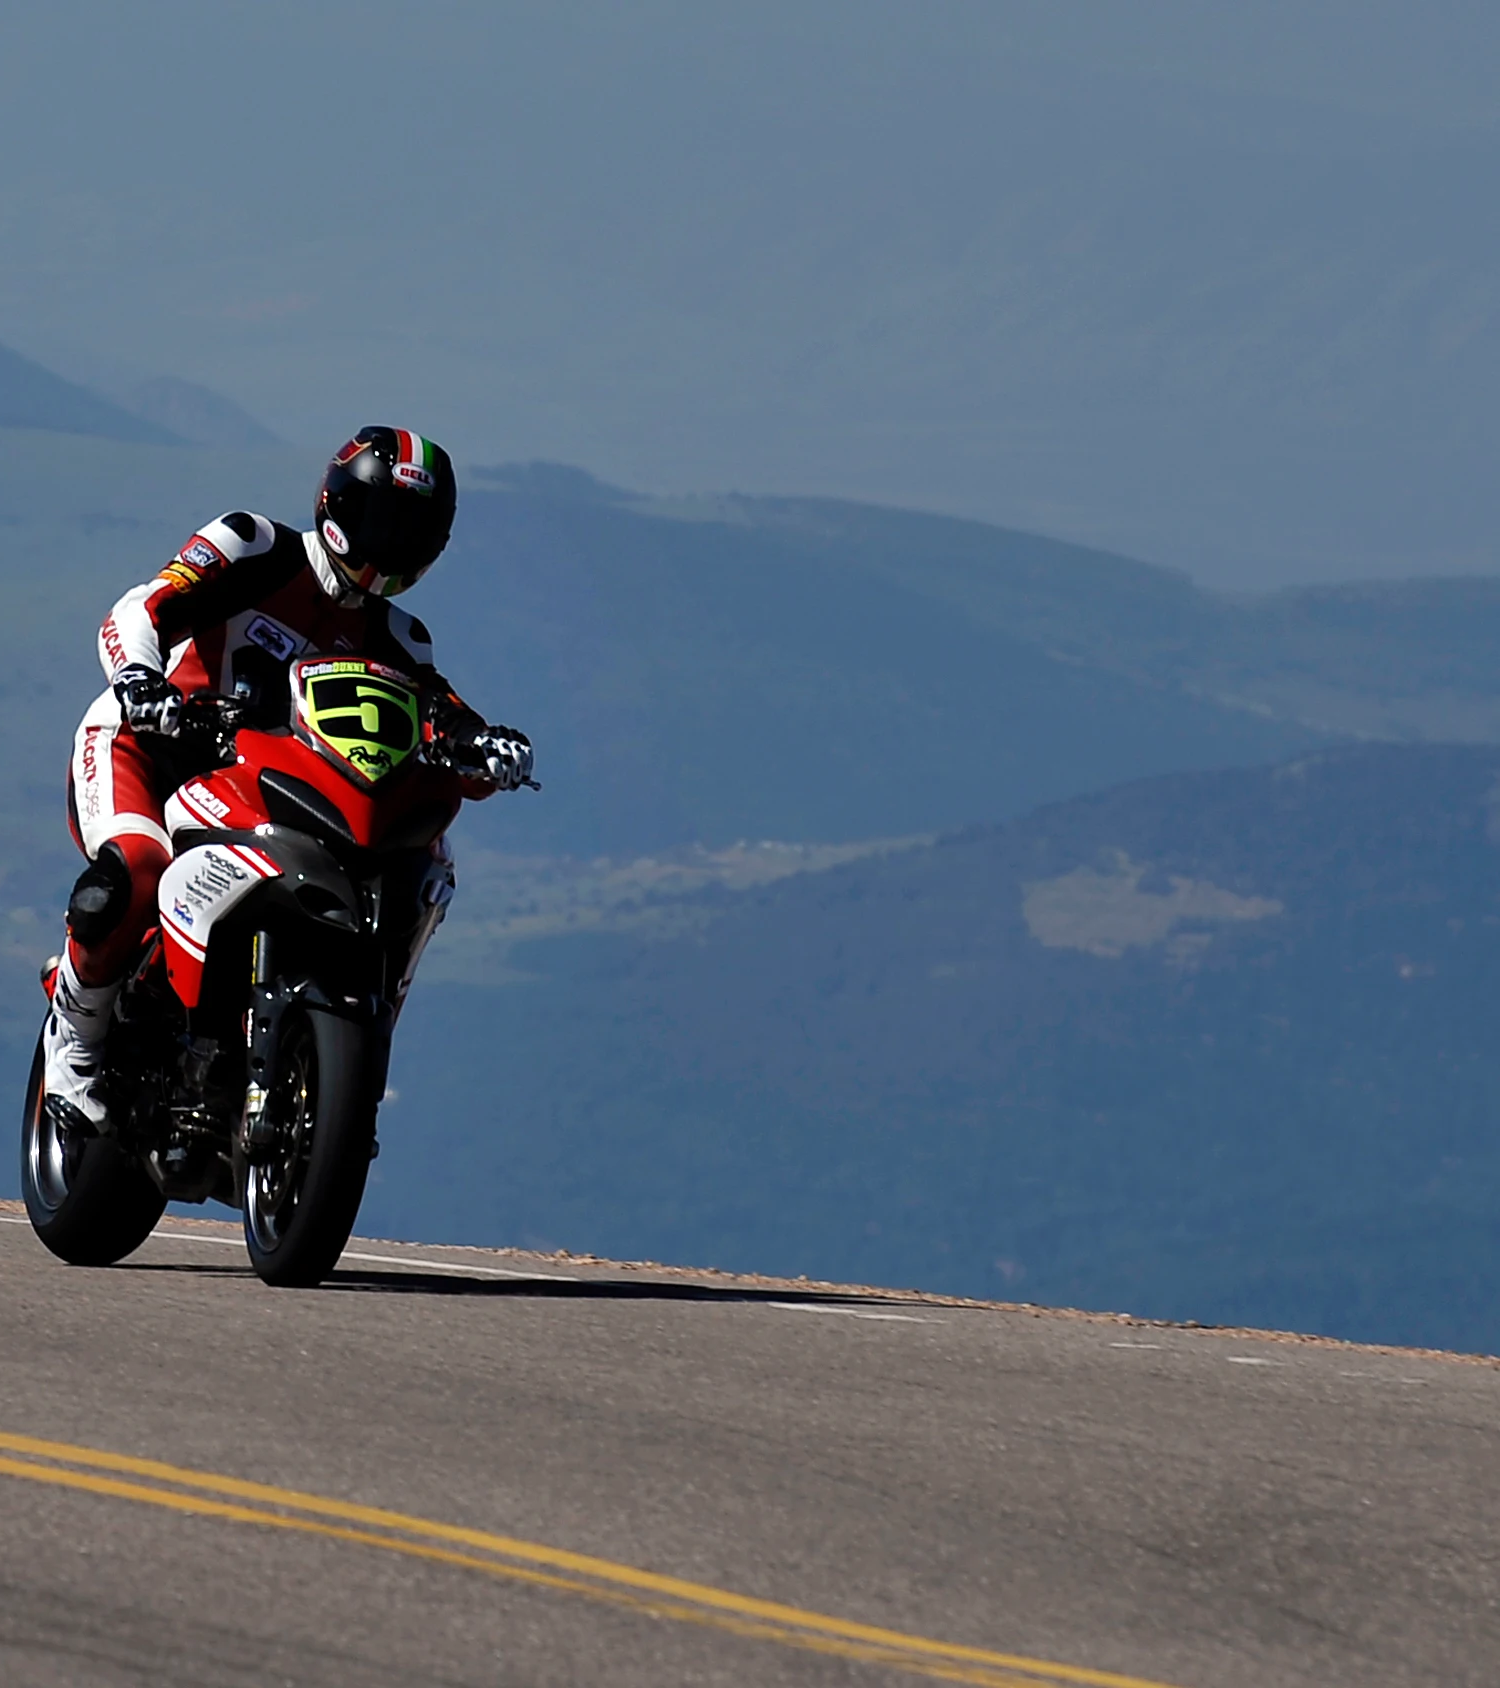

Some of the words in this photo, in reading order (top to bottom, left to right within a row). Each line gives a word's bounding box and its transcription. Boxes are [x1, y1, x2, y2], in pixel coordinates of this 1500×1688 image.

[400, 467, 431, 484] BELL
[326, 525, 344, 549] BELL
[311, 677, 414, 752] 5
[187, 782, 231, 819] DUCATI
